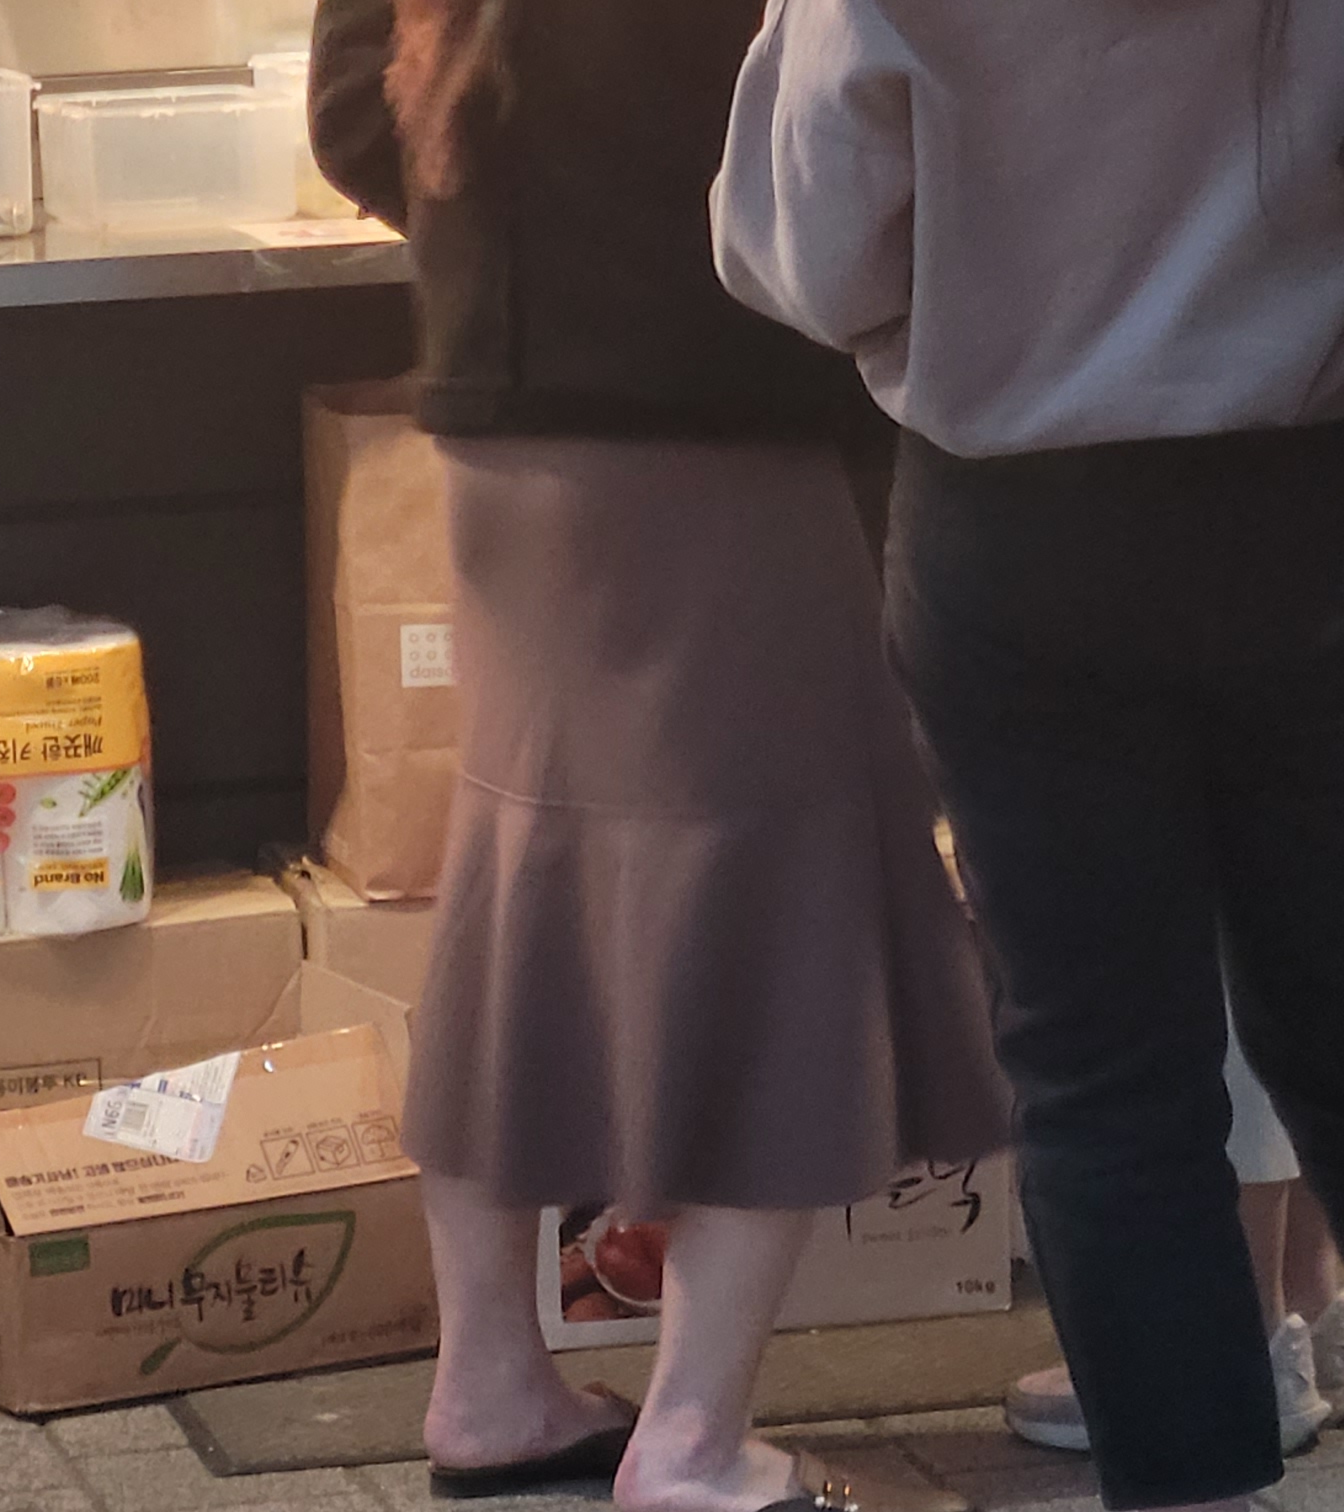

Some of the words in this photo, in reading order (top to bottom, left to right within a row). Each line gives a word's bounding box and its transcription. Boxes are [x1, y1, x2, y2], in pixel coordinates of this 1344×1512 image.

[41, 733, 103, 762] 깨끗한
[34, 873, 80, 887] Brand
[84, 871, 104, 884] No
